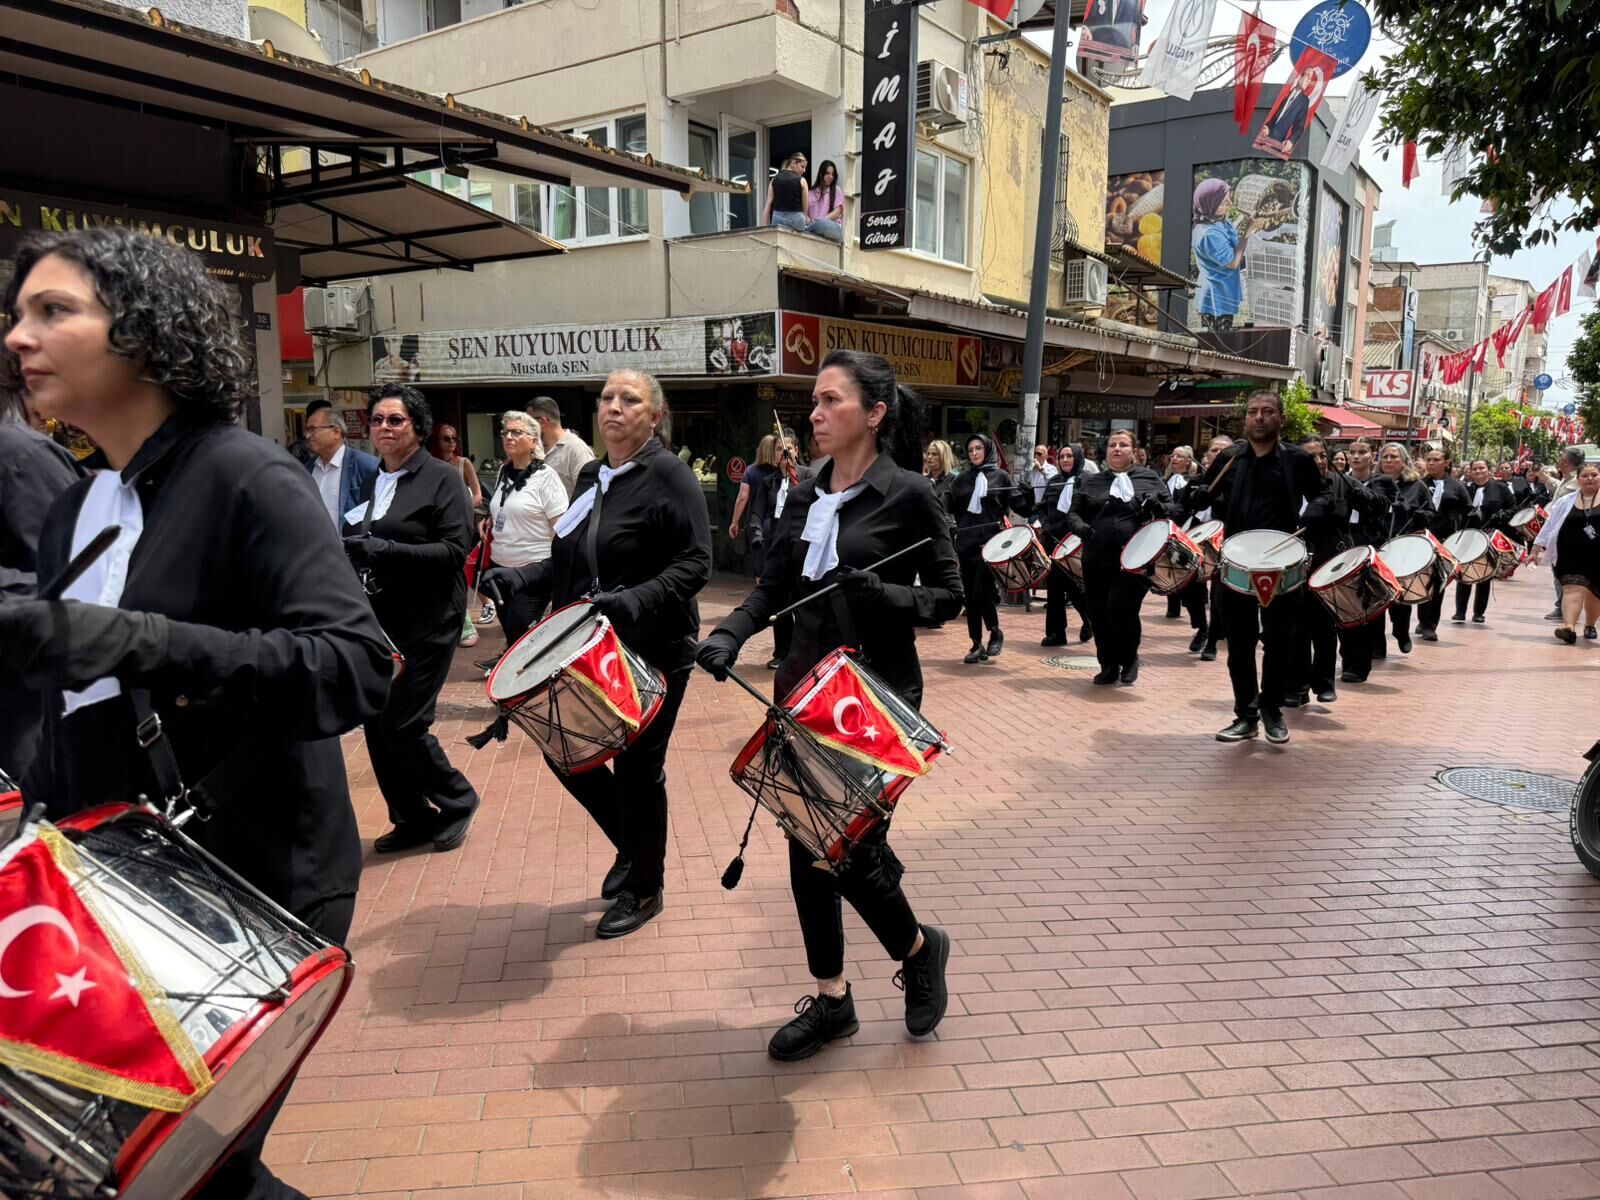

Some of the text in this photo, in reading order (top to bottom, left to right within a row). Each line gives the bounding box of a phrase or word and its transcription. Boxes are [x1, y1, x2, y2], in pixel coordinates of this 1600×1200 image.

[866, 214, 898, 227] Serap
[865, 231, 899, 246] Güray
[448, 327, 664, 366] ŞEN KUYUMCULUK
[861, 330, 954, 362] KUYUMCULUK
[511, 360, 590, 377] Mustafa ŞEN
